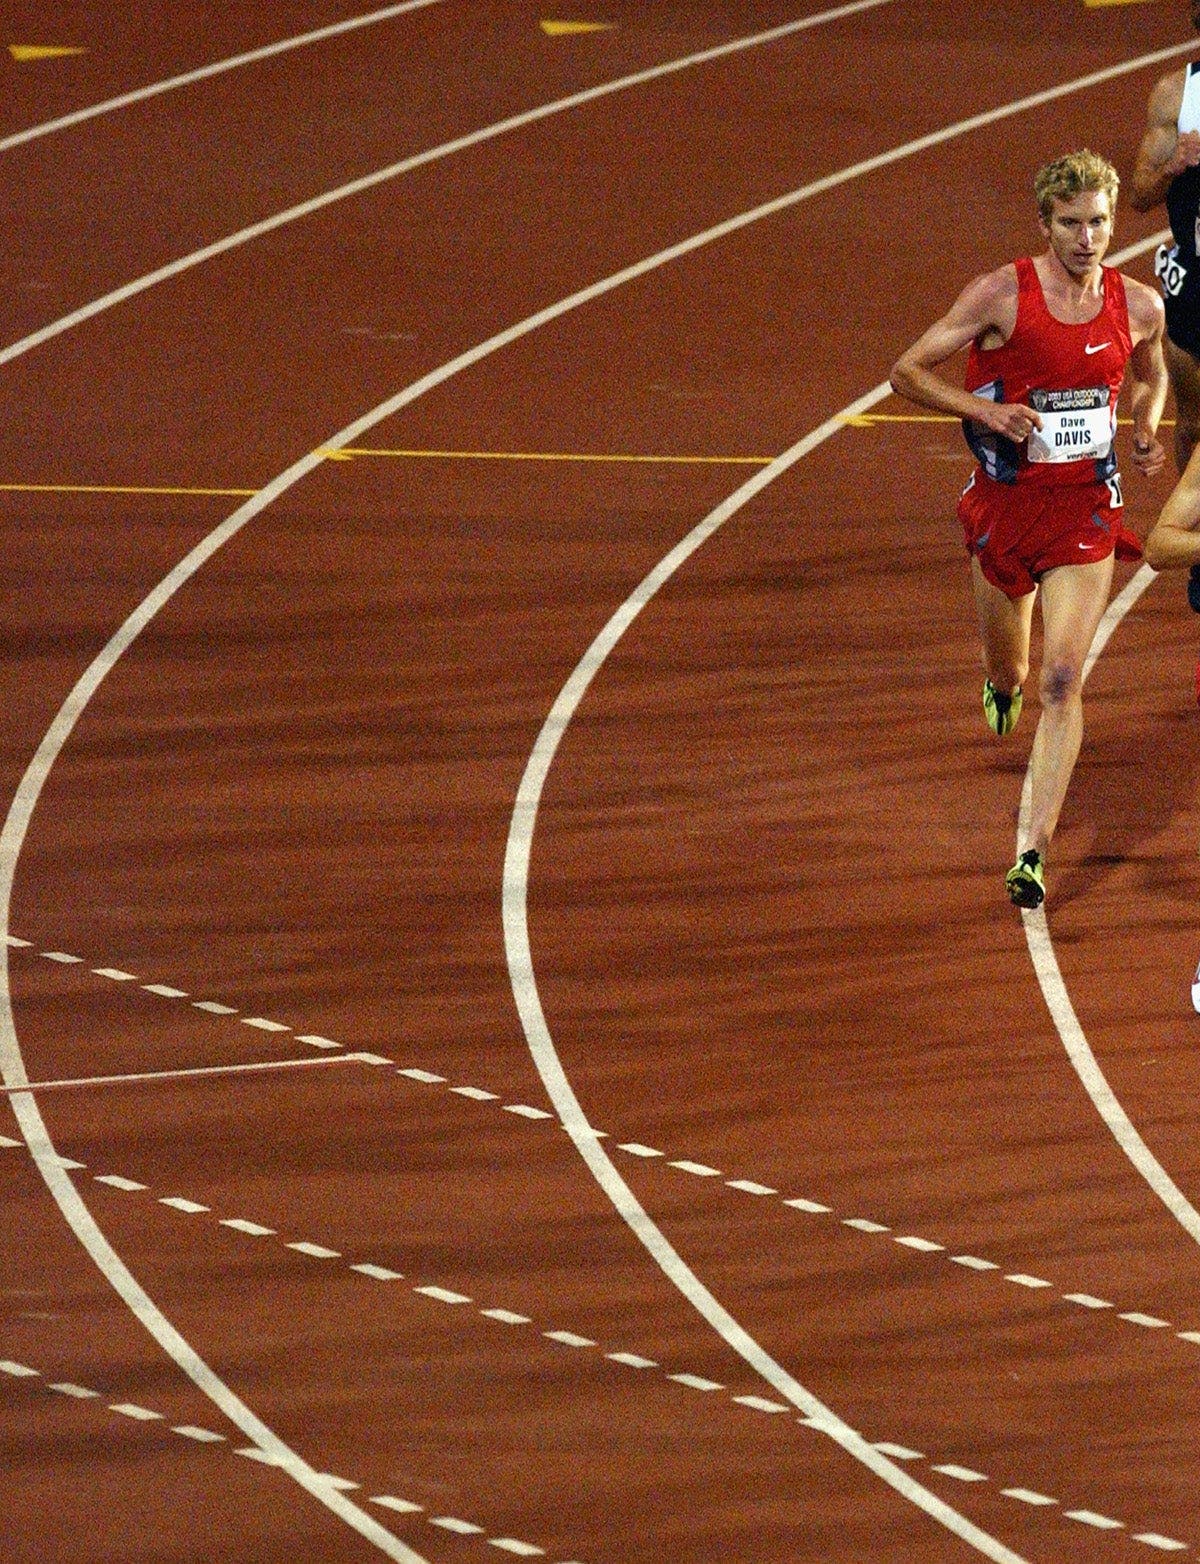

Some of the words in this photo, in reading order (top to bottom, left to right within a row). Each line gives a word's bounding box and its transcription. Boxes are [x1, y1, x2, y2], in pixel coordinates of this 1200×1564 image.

[1062, 389, 1073, 401] USA
[1073, 388, 1100, 401] OUTDOOR
[1060, 417, 1086, 428] Dave
[1055, 429, 1092, 446] DAVIS
